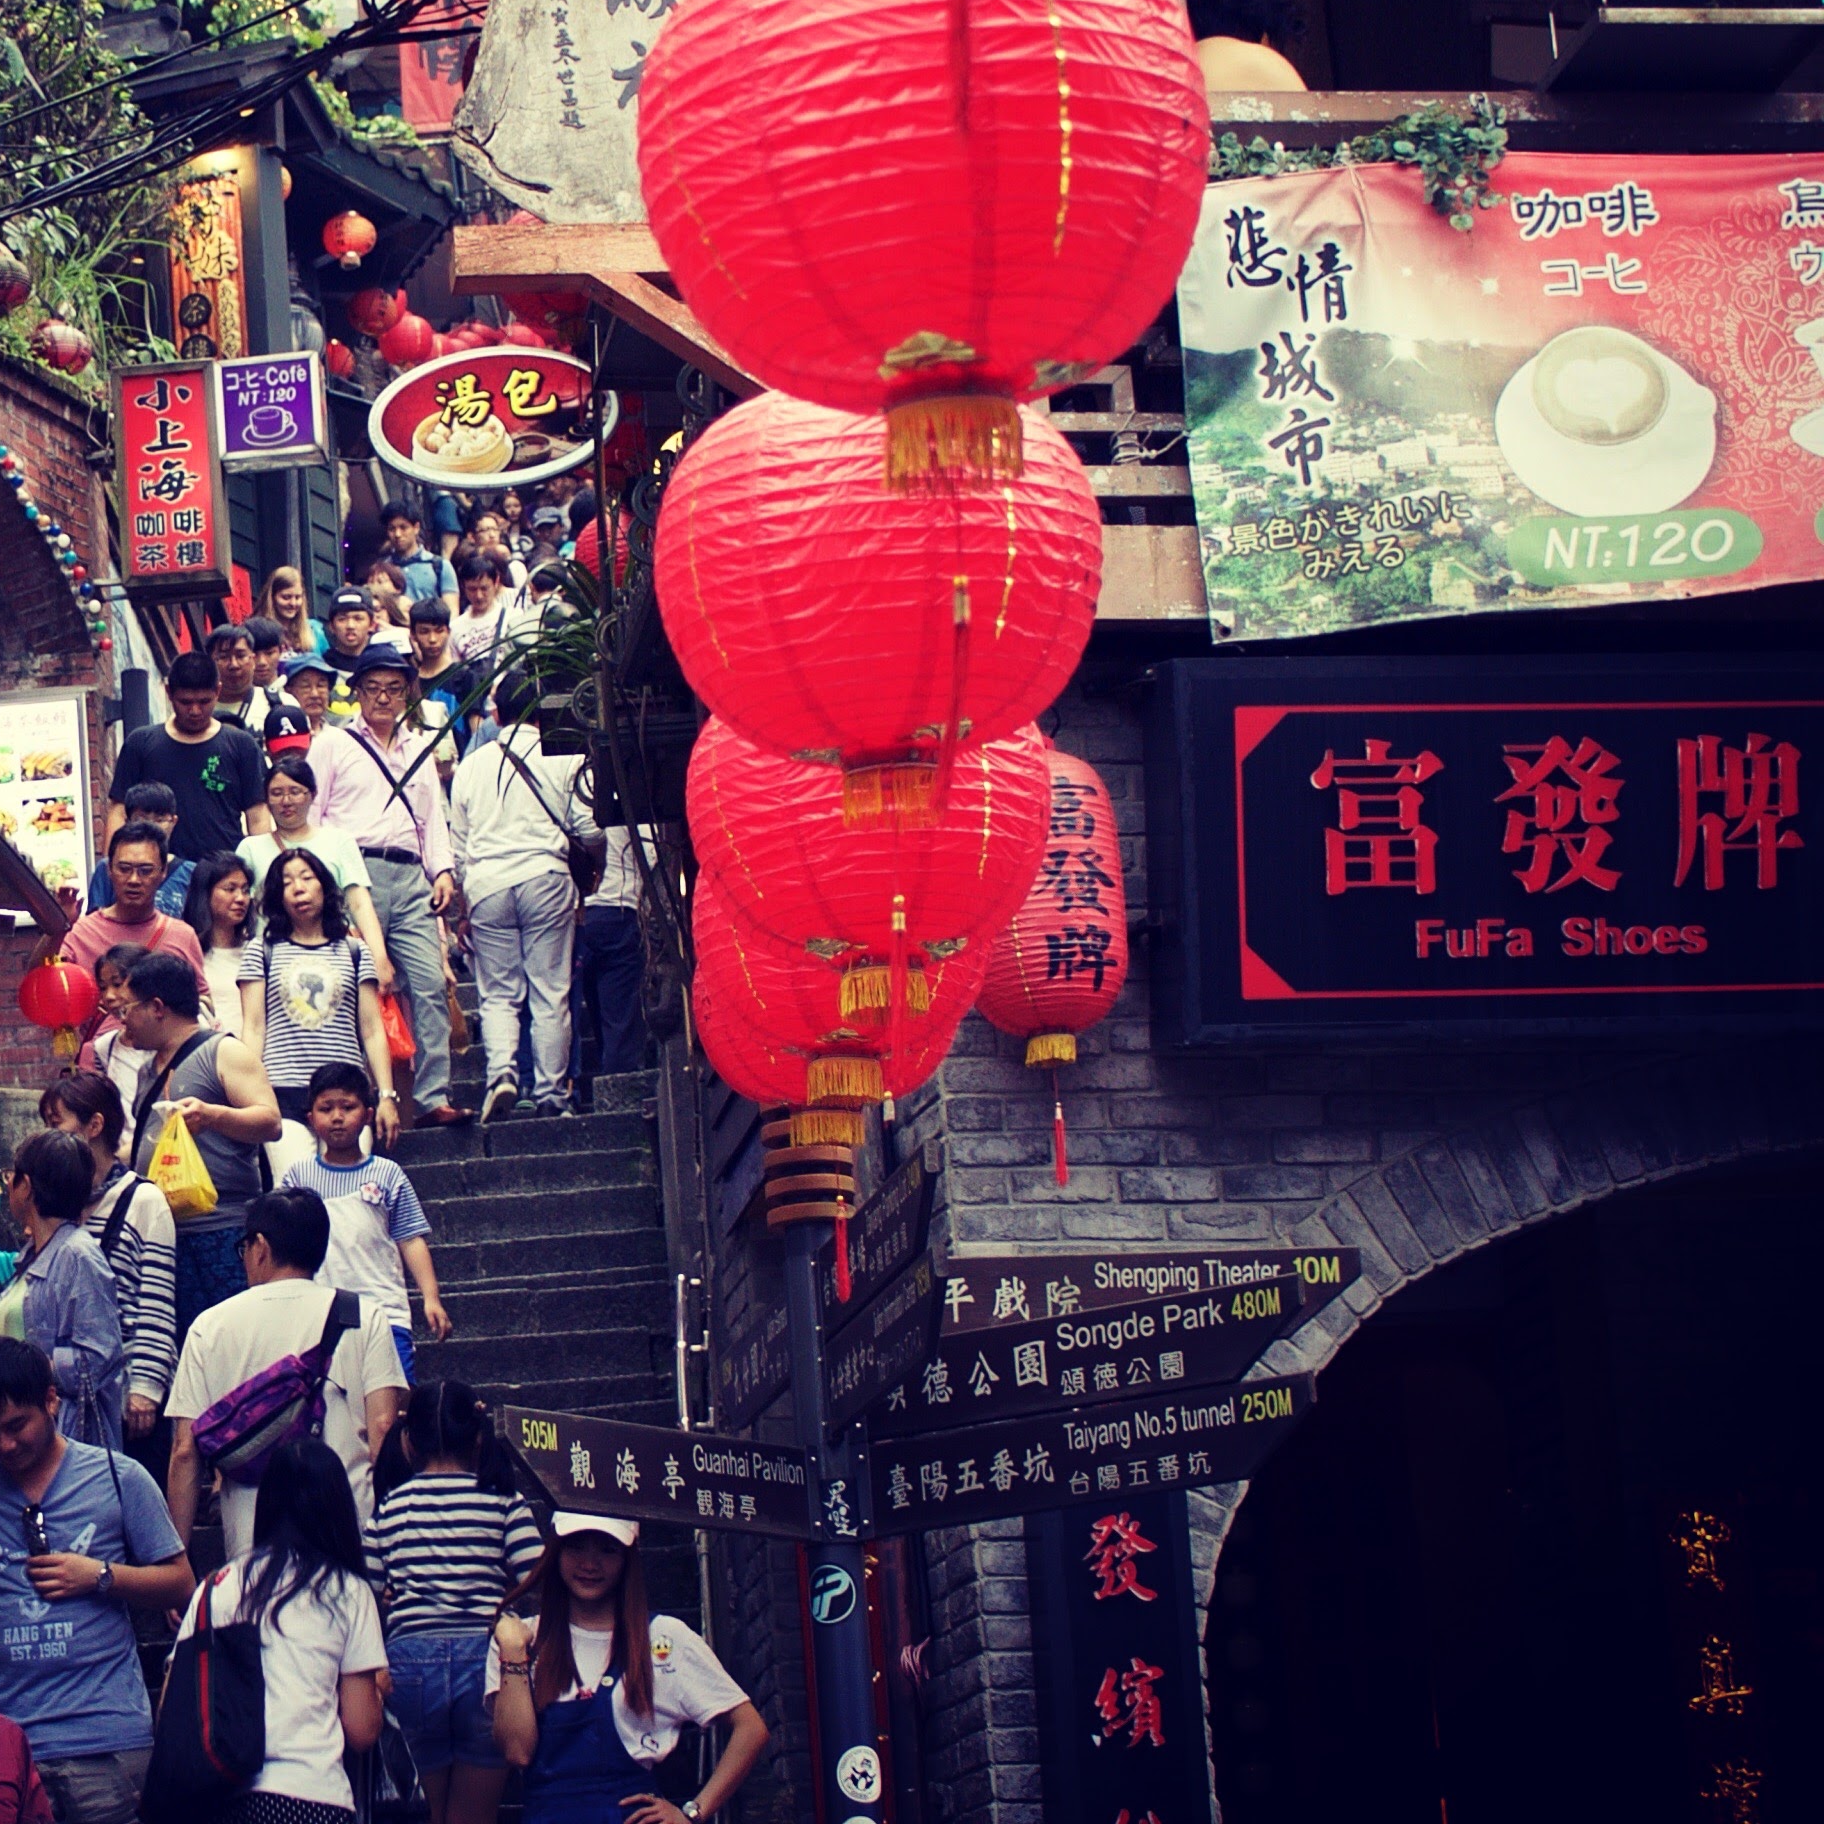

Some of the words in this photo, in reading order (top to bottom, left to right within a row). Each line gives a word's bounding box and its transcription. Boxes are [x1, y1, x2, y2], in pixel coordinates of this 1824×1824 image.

[1511, 182, 1659, 239] 咖啡
[1222, 206, 1353, 486] 悲情城市
[435, 369, 558, 427] 湯包
[134, 378, 199, 504] 小上海
[136, 508, 206, 538] 咖啡
[1229, 490, 1472, 557] 景色がきれいに
[136, 540, 207, 571] 茶樓
[1302, 534, 1406, 581] みえる
[1310, 730, 1806, 897] 富發牌
[1033, 776, 1119, 993] 富發牌
[1415, 917, 1535, 960] FuFa
[1561, 916, 1709, 957] Shoes
[1093, 1261, 1200, 1295] Shengping
[1203, 1259, 1281, 1287] Theater
[1056, 1314, 1156, 1353] Songde
[1163, 1297, 1225, 1335] Park
[1231, 1287, 1281, 1322] 480M
[521, 1418, 559, 1453] 505M
[1063, 1413, 1131, 1456] Taiyang
[1181, 1400, 1237, 1433] tunnel
[1241, 1387, 1294, 1424] 250M
[568, 1439, 687, 1501] 觀海亭
[692, 1443, 750, 1479] Guanhai
[752, 1454, 806, 1487] Pavilion
[886, 1442, 1056, 1511] 臺陽五番坑
[1069, 1451, 1213, 1497] 台陽五番坑
[3, 1625, 40, 1645] HANG
[44, 1621, 74, 1640] TEN
